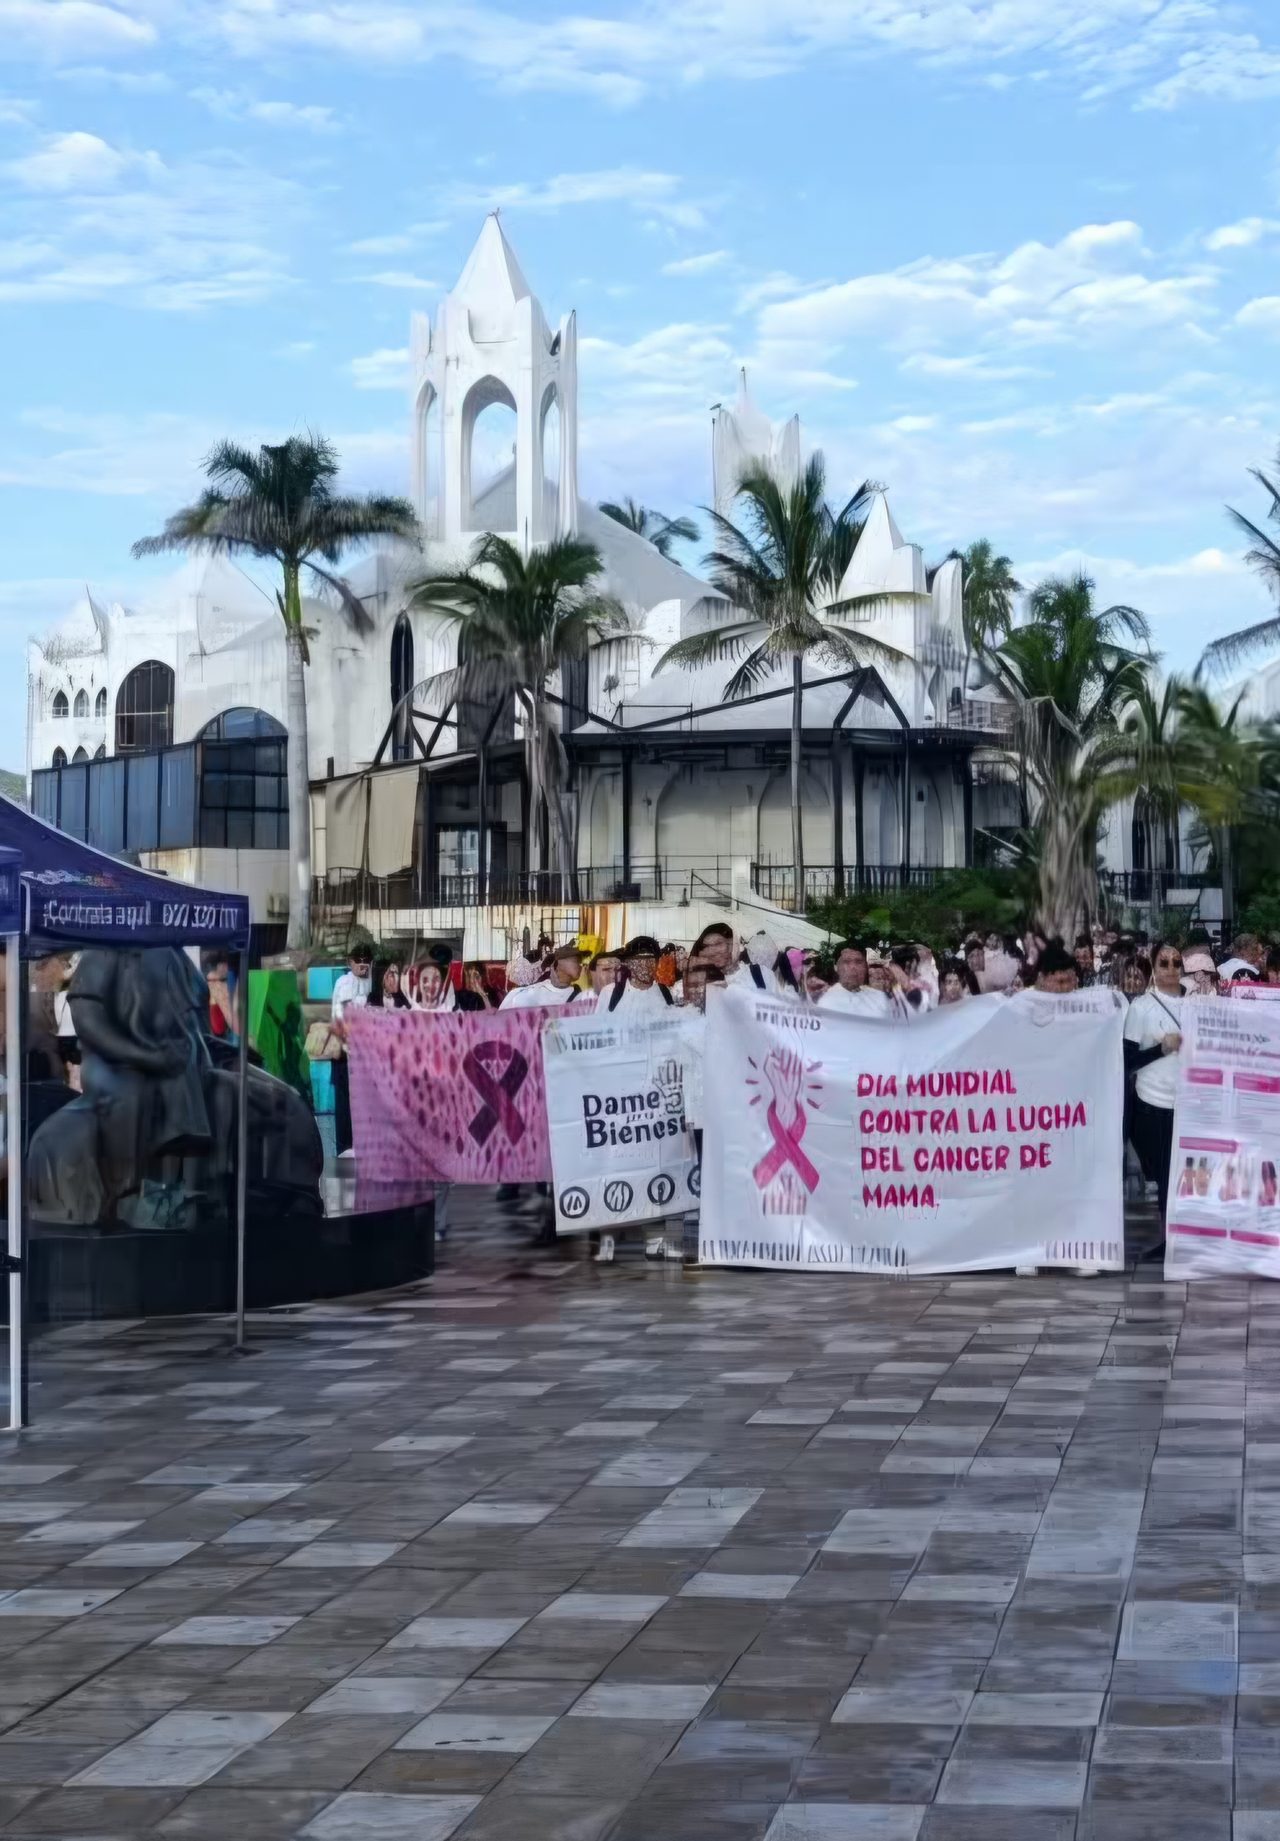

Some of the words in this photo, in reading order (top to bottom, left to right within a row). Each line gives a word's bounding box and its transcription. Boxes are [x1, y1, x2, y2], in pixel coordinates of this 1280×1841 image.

[906, 1069, 1017, 1097] MUNDIAL
[582, 1090, 660, 1117] Dame
[859, 1107, 959, 1135] CONTRA
[967, 1107, 997, 1133] LA
[1006, 1101, 1087, 1132] LUCHA
[585, 1115, 687, 1149] Bienest
[861, 1146, 904, 1172] DEL
[913, 1145, 1010, 1172] CANCER
[1020, 1142, 1052, 1170] DE
